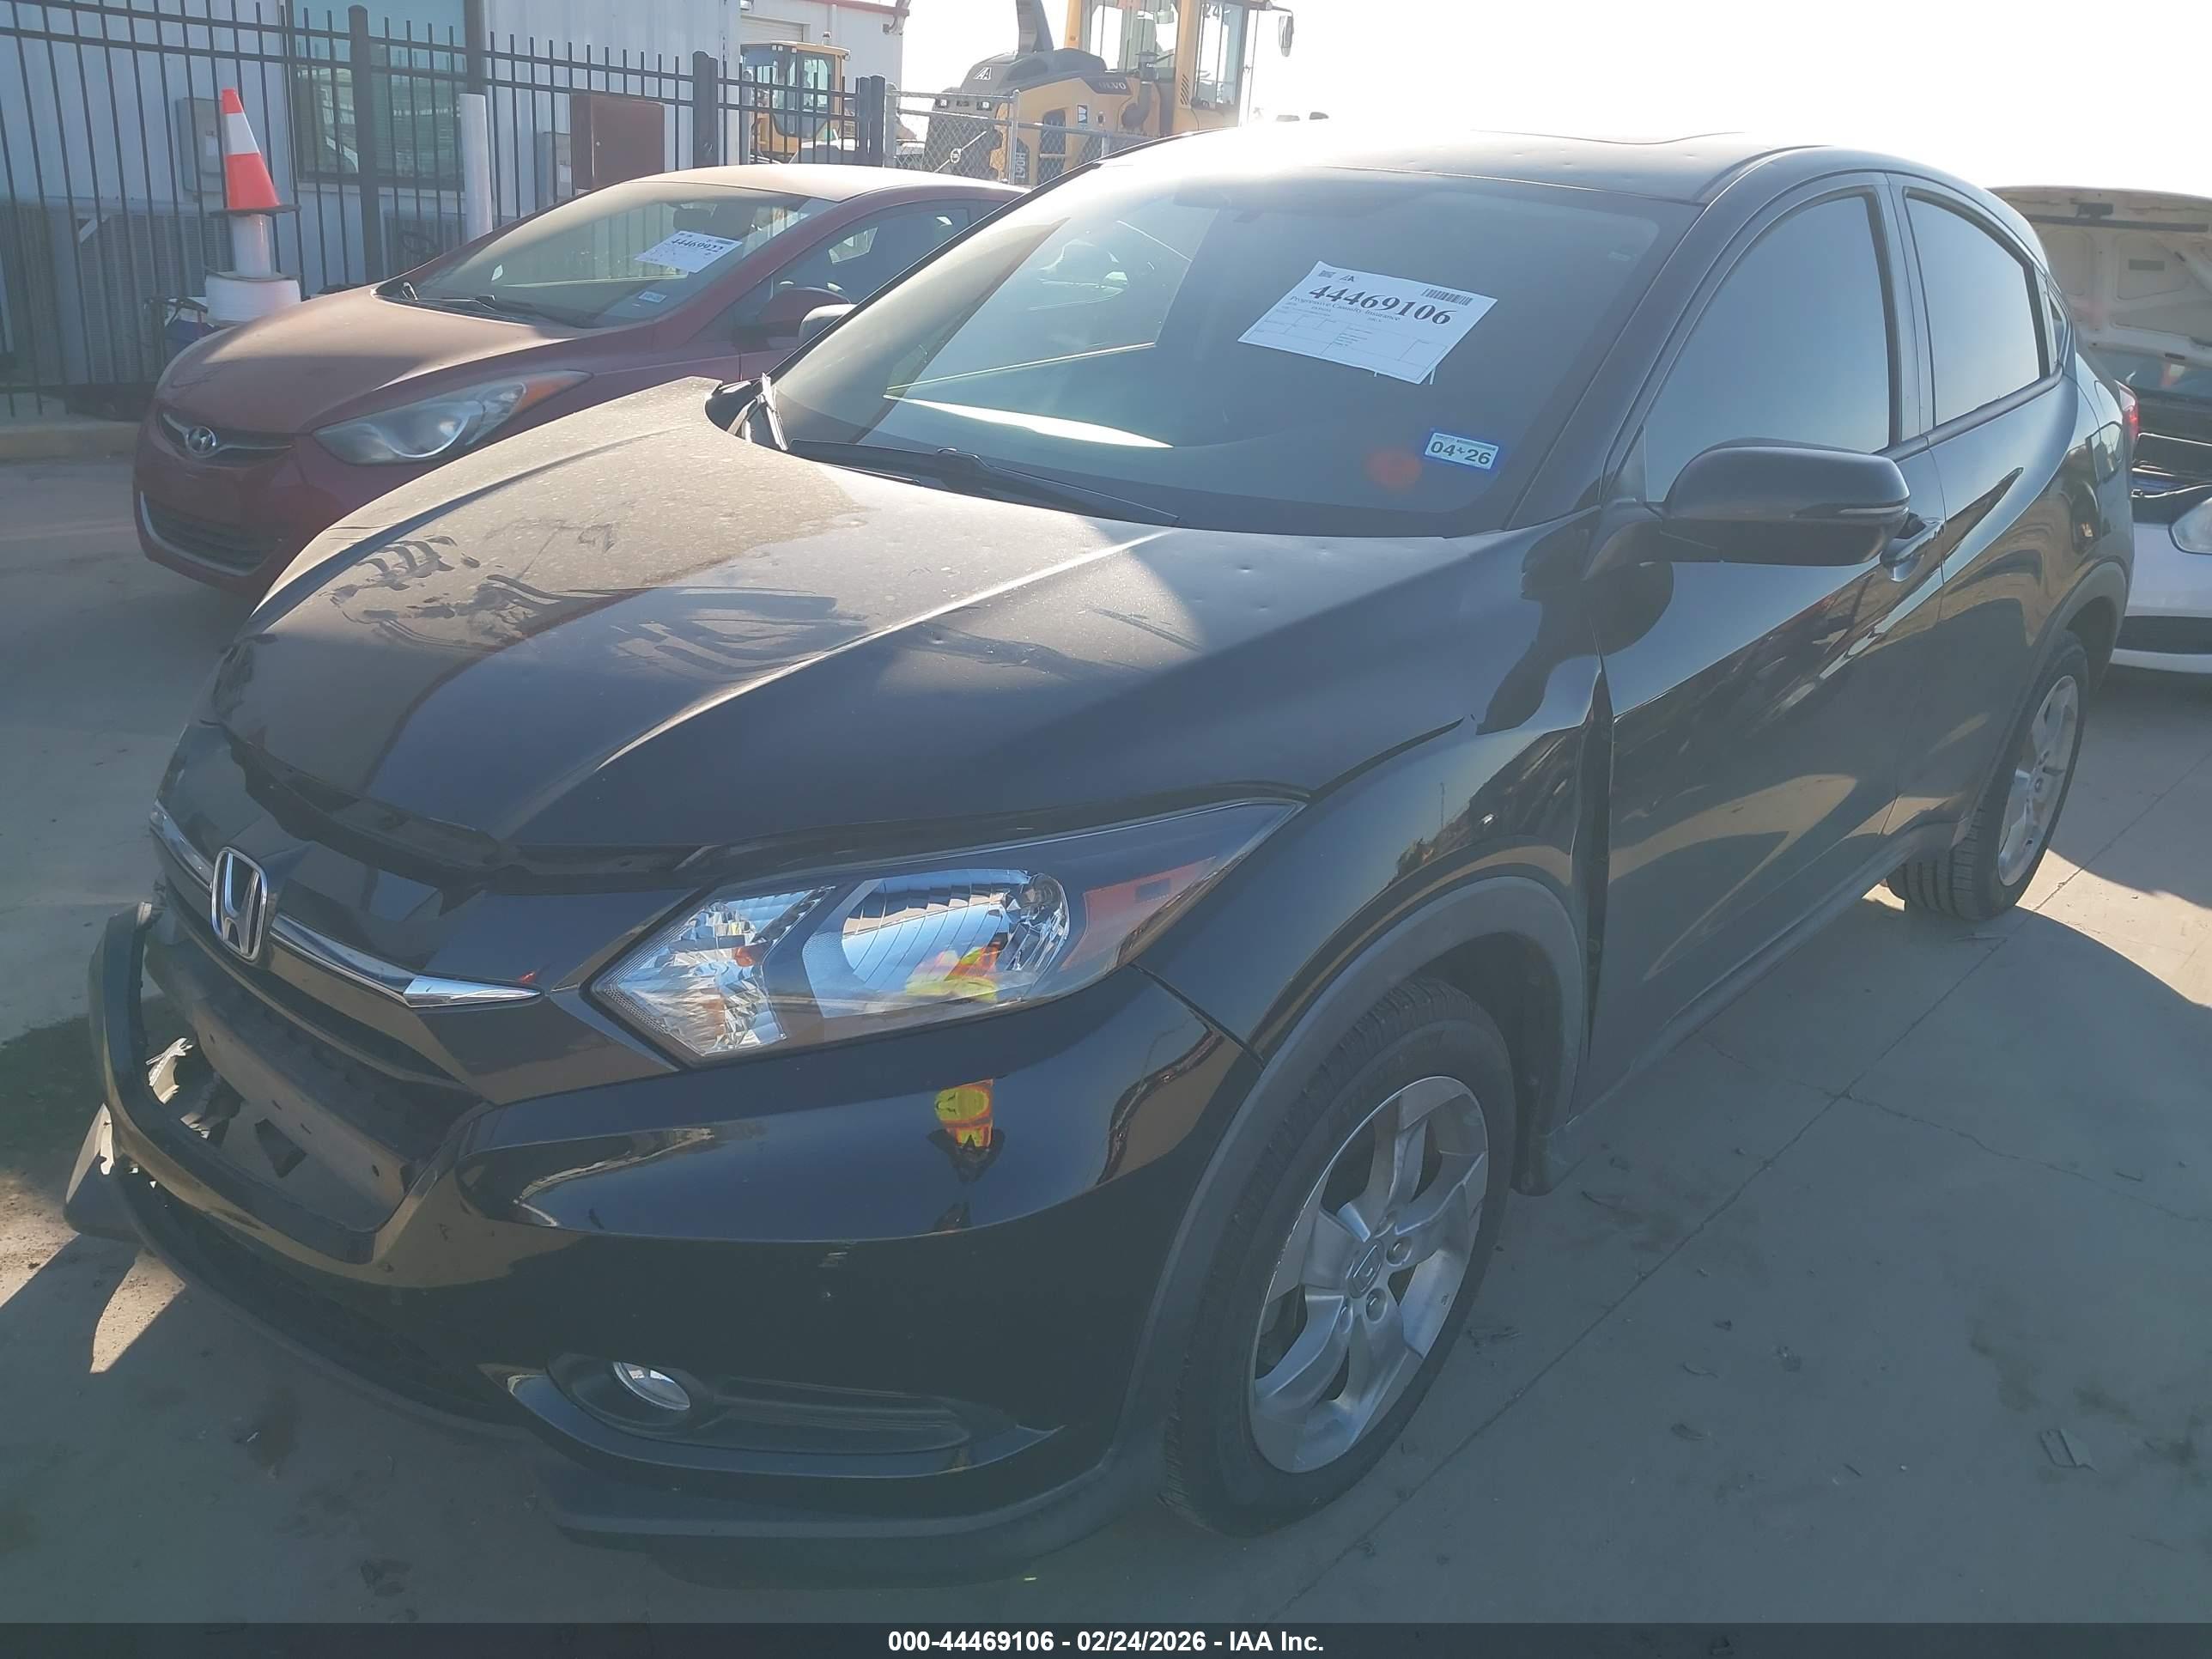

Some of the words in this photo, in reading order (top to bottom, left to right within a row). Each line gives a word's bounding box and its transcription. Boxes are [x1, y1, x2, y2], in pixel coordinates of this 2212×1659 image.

[1309, 284, 1457, 325] 44469106
[1431, 441, 1456, 457] 04
[1464, 448, 1492, 465] 26
